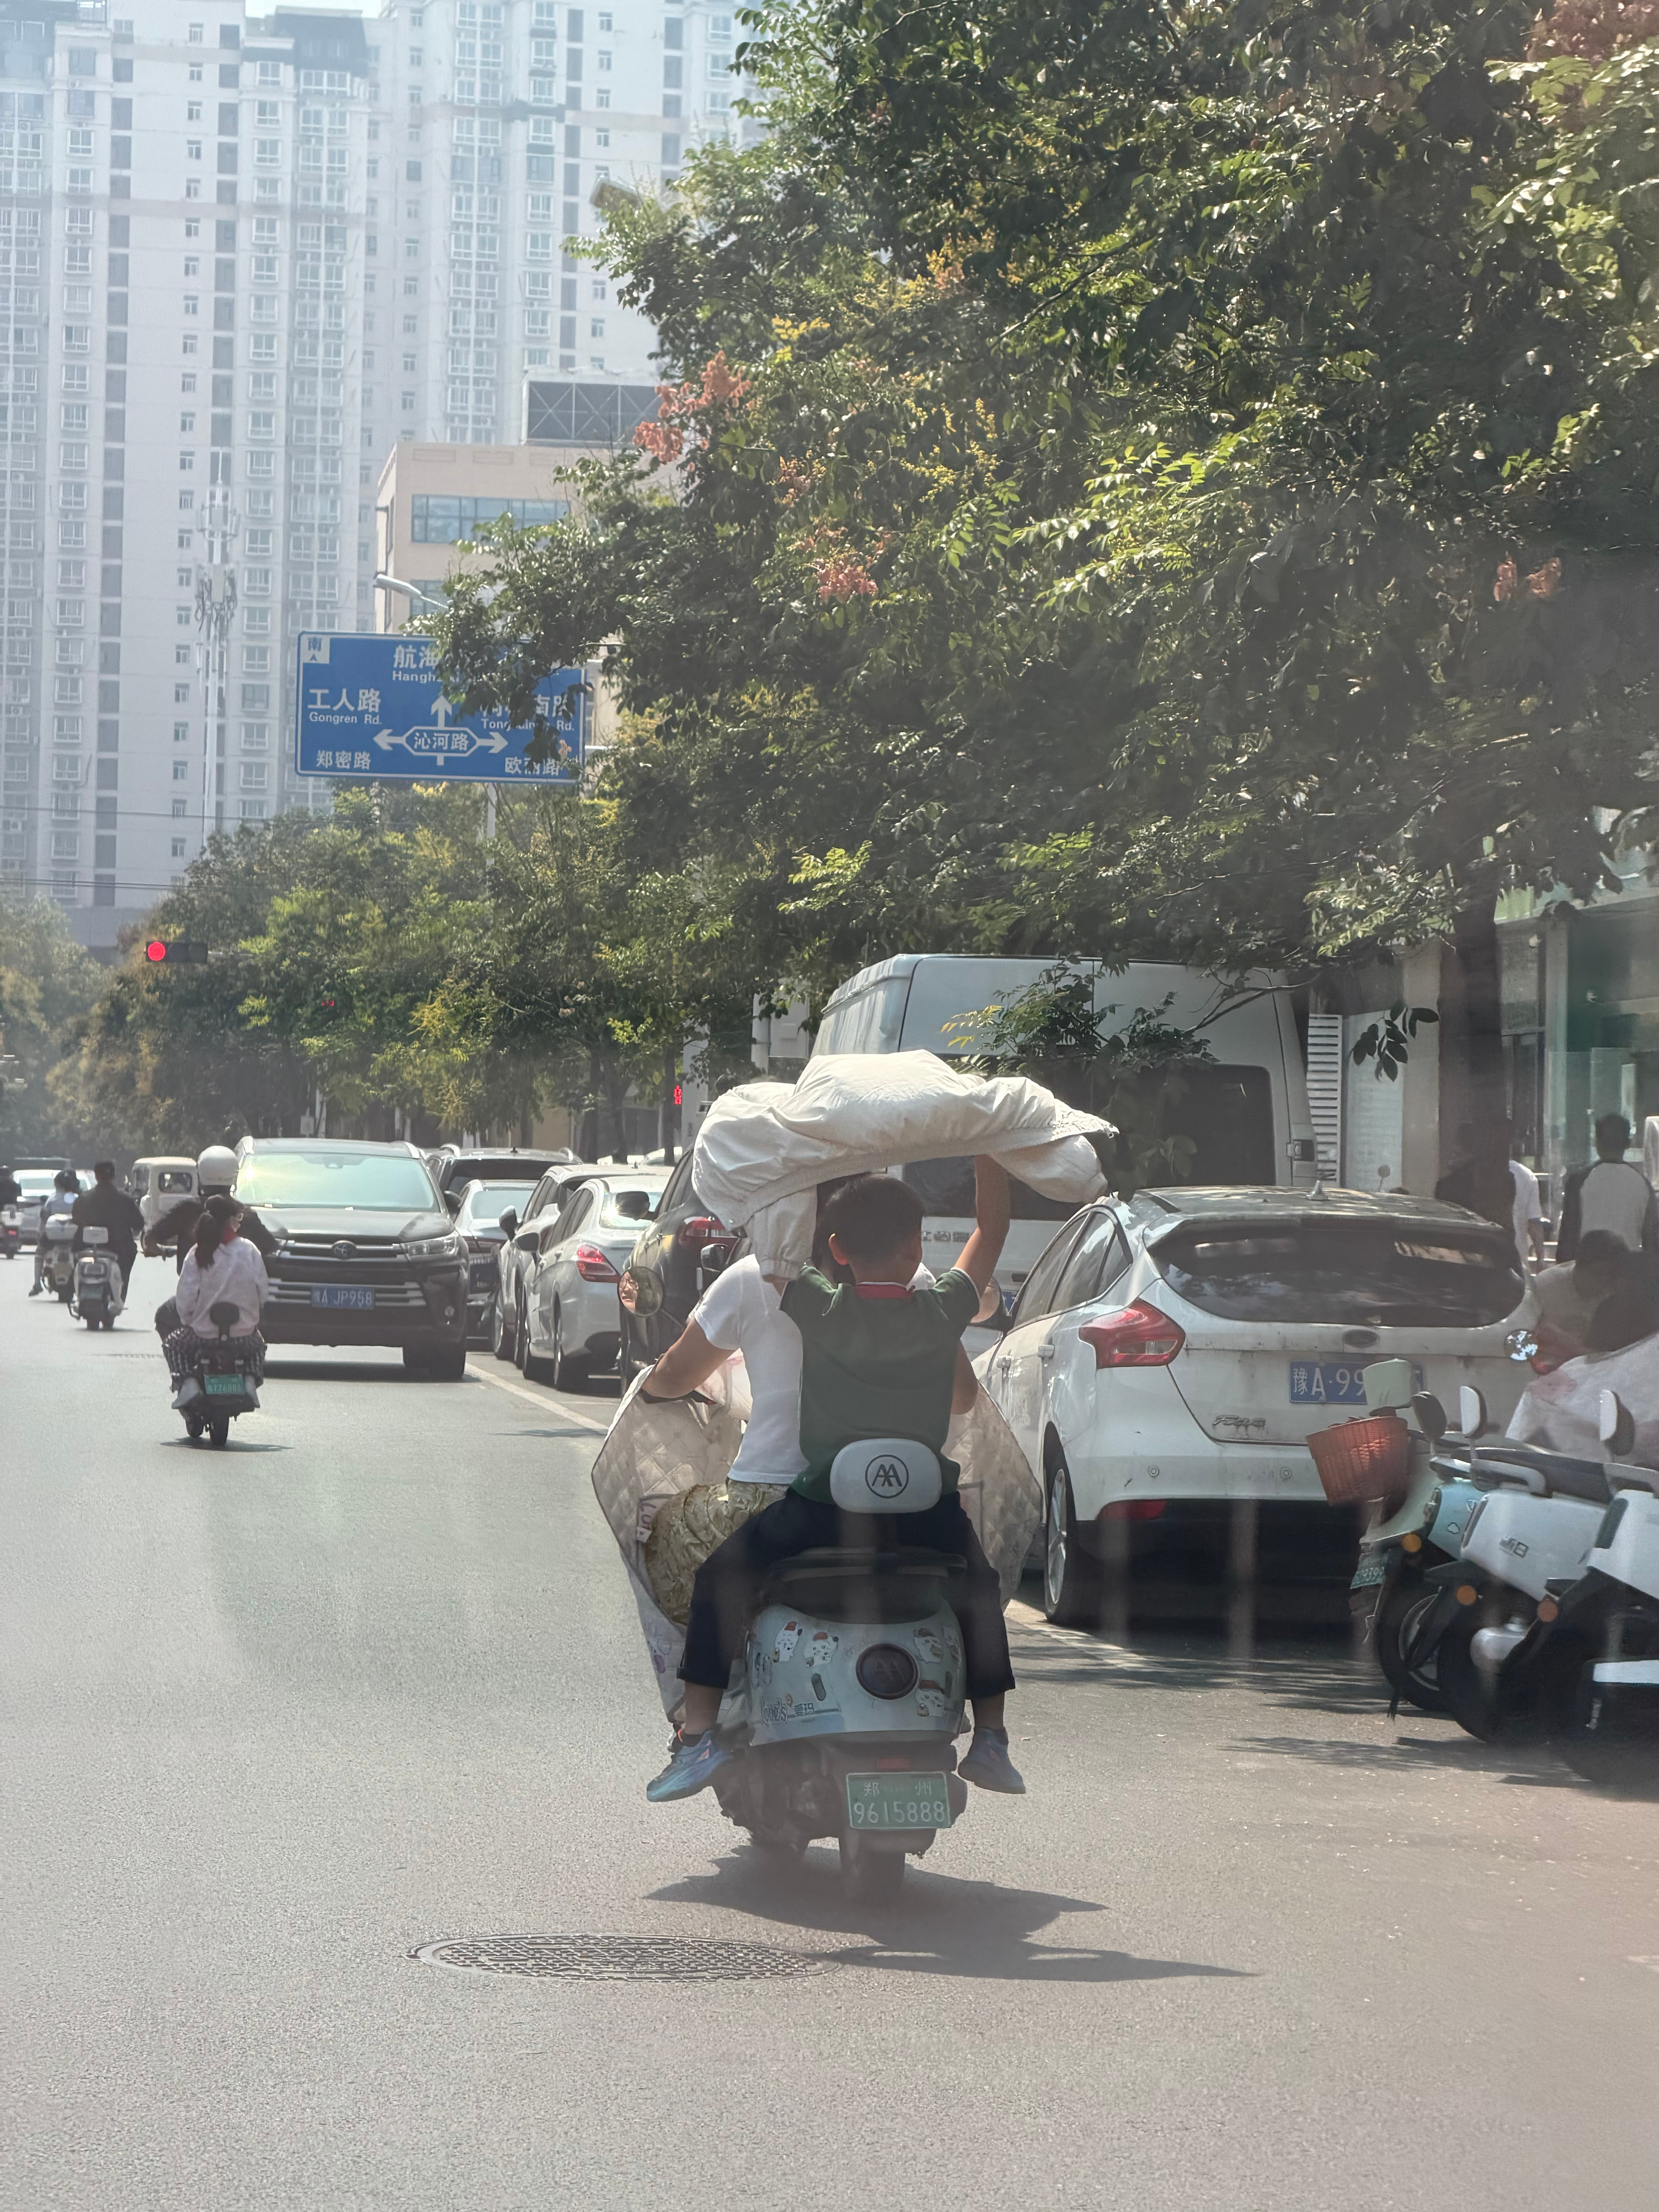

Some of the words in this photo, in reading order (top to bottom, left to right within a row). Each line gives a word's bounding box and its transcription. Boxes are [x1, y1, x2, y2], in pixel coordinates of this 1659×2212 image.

[307, 688, 381, 712] 工人路
[309, 712, 357, 725] Gongren
[364, 714, 382, 725] Rd.
[557, 720, 574, 731] Rd.
[414, 732, 469, 750] 沁河路
[316, 750, 371, 769] 郑密路
[864, 1781, 932, 1796] 郑州
[854, 1801, 945, 1823] 9615888
